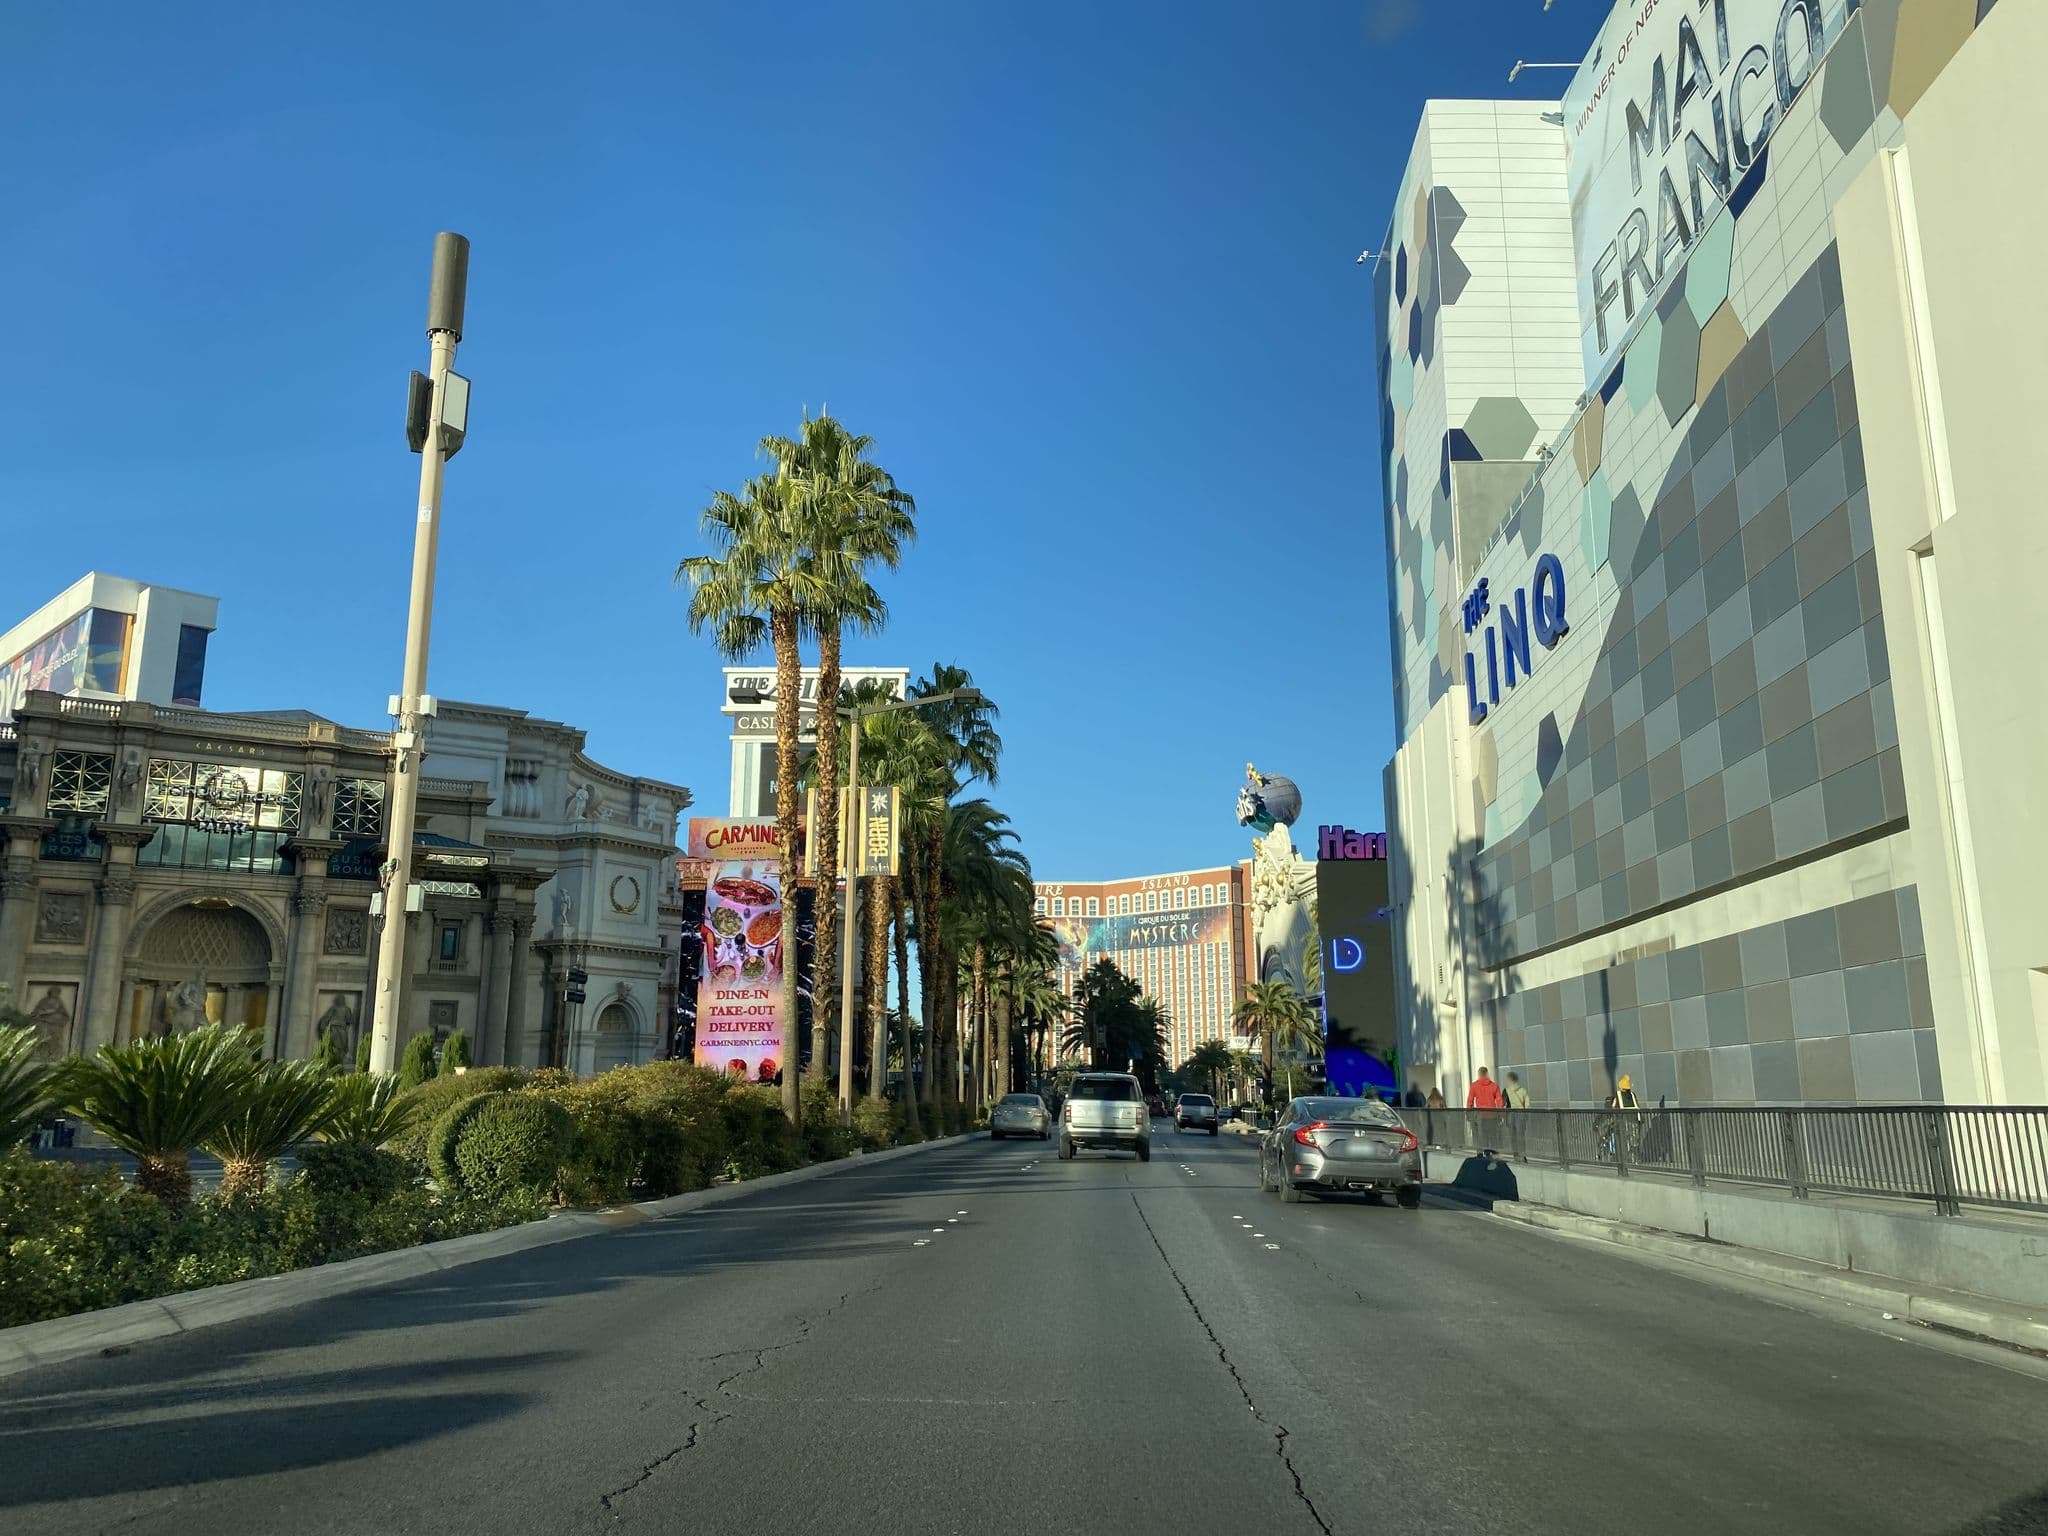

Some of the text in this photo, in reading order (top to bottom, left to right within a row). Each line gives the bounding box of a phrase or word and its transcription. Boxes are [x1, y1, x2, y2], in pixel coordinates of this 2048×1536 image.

[1576, 0, 1660, 136] WINNER OF NB
[1592, 0, 1824, 356] FRANCO
[1462, 577, 1490, 636] THE
[1464, 553, 1570, 726] LINQ
[735, 677, 769, 691] THE
[706, 824, 781, 849] CARMINE
[1318, 825, 1387, 860] Harr
[1141, 875, 1190, 890] ISLAND
[1138, 911, 1190, 925] CIRQUE DU SOLEIL
[716, 989, 769, 1000] DINE-IN
[709, 1005, 775, 1016] TAKE-OUT
[708, 1021, 774, 1032] DELIVERY
[700, 1039, 780, 1047] CARMINESNYC.COM
